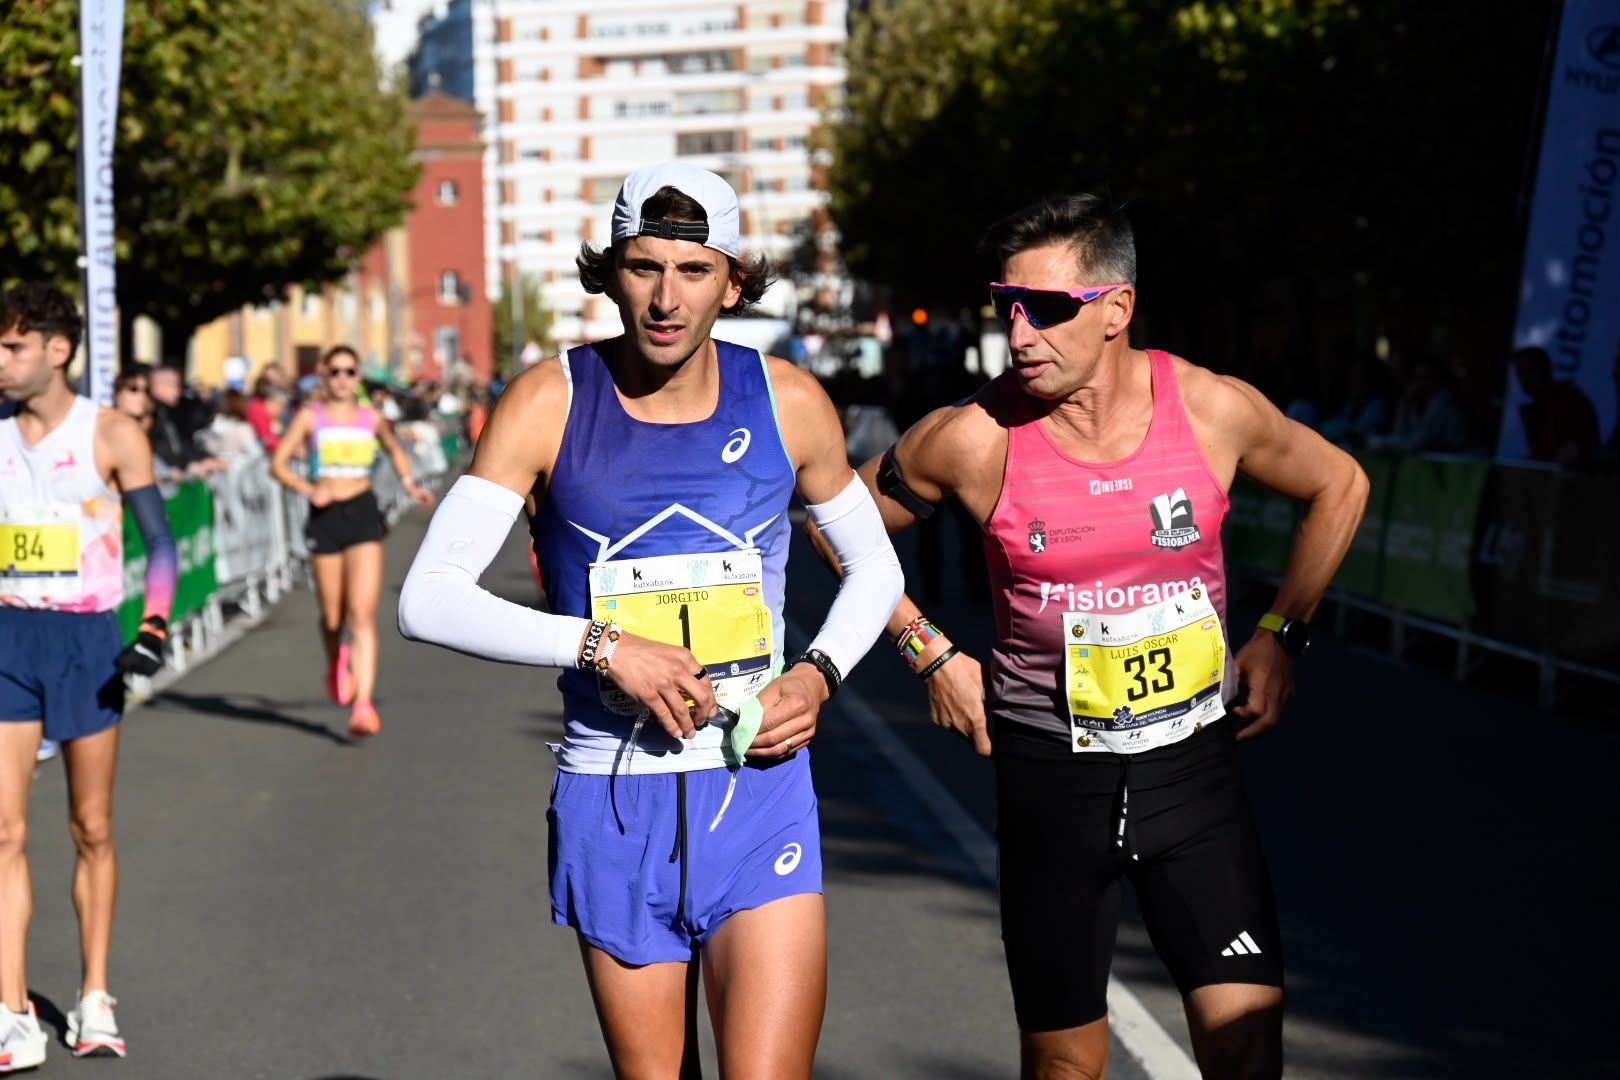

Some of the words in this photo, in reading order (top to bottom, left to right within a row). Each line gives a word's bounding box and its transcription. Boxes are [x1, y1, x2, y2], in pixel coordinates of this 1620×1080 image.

[1101, 478, 1133, 492] INVERSE
[1049, 525, 1096, 537] DIPUTACIÓN
[1151, 530, 1200, 548] FISIORAMA
[14, 533, 44, 561] 84
[1049, 537, 1059, 545] DE
[1060, 534, 1082, 544] LEÓN
[633, 579, 674, 589] kutxabank
[724, 572, 758, 581] kutxabank
[655, 590, 709, 606] JORGITO
[678, 603, 691, 651] 1
[1110, 645, 1139, 660] LUIS
[1143, 634, 1179, 652] OSCAR
[1124, 646, 1175, 702] 33
